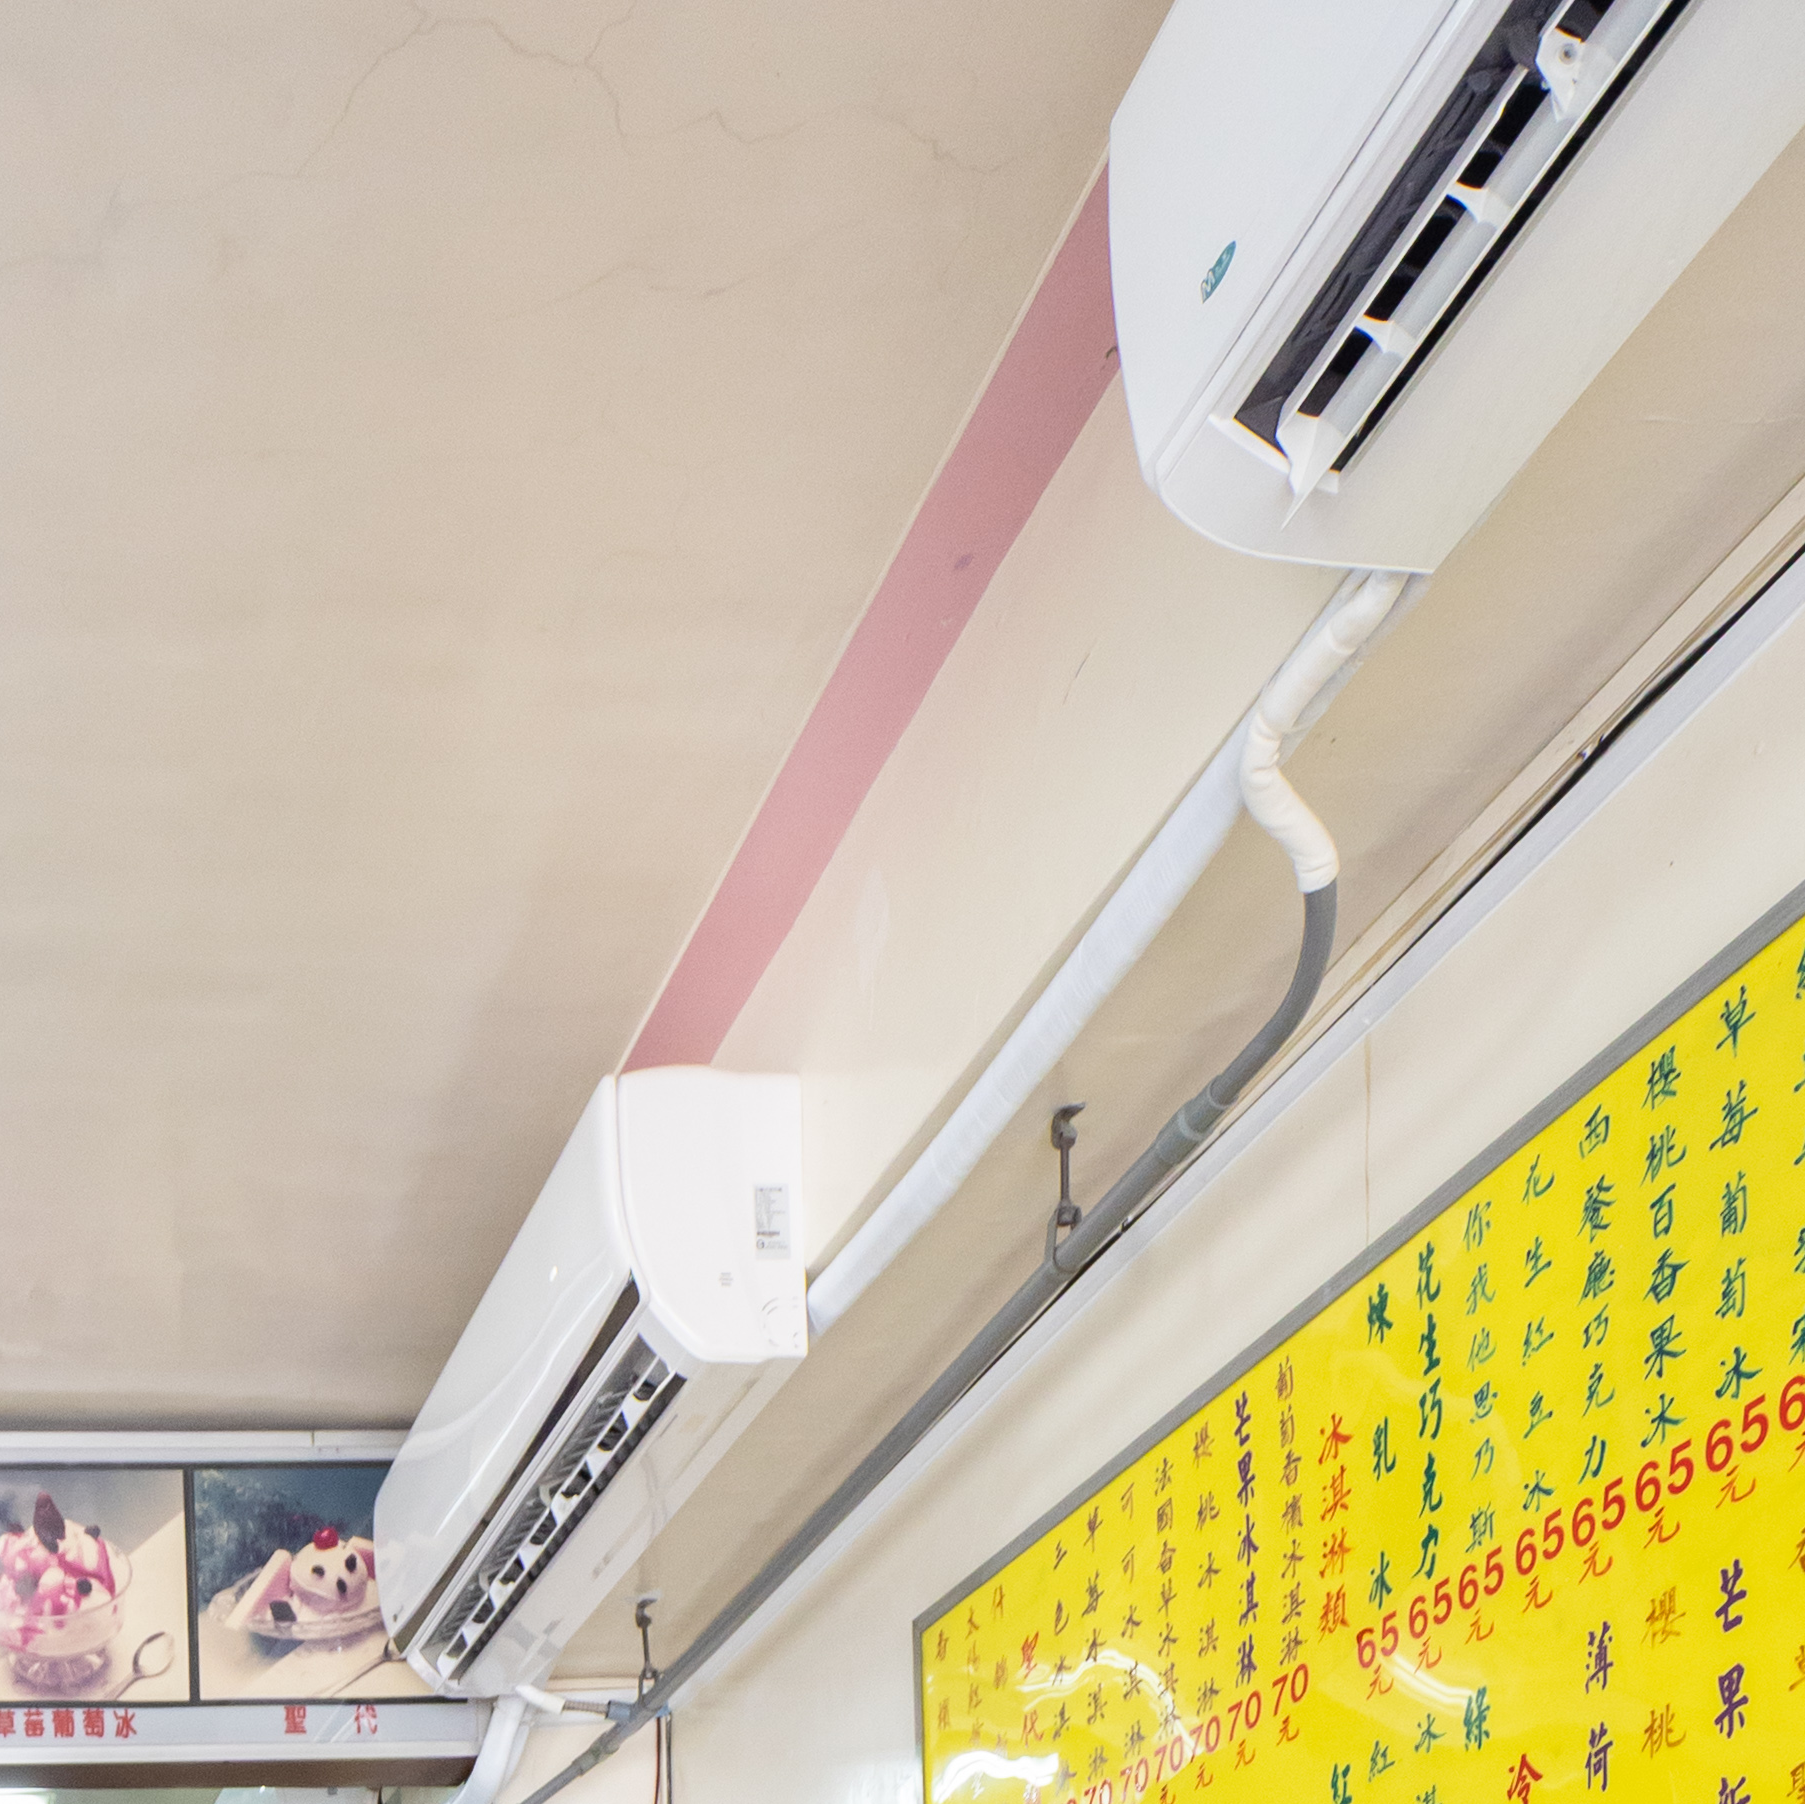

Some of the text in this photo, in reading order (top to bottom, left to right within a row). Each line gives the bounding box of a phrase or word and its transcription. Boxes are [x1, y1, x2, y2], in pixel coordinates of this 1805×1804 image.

[1708, 984, 1763, 1400] 草莓葡萄冰
[1639, 1045, 1691, 1448] 櫻桃百香果冰
[1576, 1103, 1616, 1484] 西餐廳巧克力
[1521, 1153, 1556, 1513] 花生紅豆冰
[1366, 1281, 1396, 1611] 煉乳冰
[1412, 1240, 1443, 1580] 花生巧克力
[1703, 1397, 1768, 1474] 65
[1570, 1477, 1627, 1547] 65
[1632, 1439, 1696, 1513] 65
[1232, 1390, 1260, 1688] 芒果冰淇淋
[1317, 1411, 1353, 1644] 冰淇淋類
[1514, 1506, 1566, 1576] 65
[1193, 1420, 1223, 1717] 櫻桃冰淇淋
[1457, 1547, 1505, 1610] 65
[1119, 1481, 1147, 1759] 可可冰淇淋
[1356, 1612, 1400, 1670] 65
[1407, 1577, 1453, 1640] 65
[1227, 1689, 1263, 1742] 70
[1271, 1662, 1309, 1717] 70
[1153, 1735, 1185, 1784] 70
[1188, 1713, 1221, 1763] 70
[1119, 1757, 1150, 1804] 70
